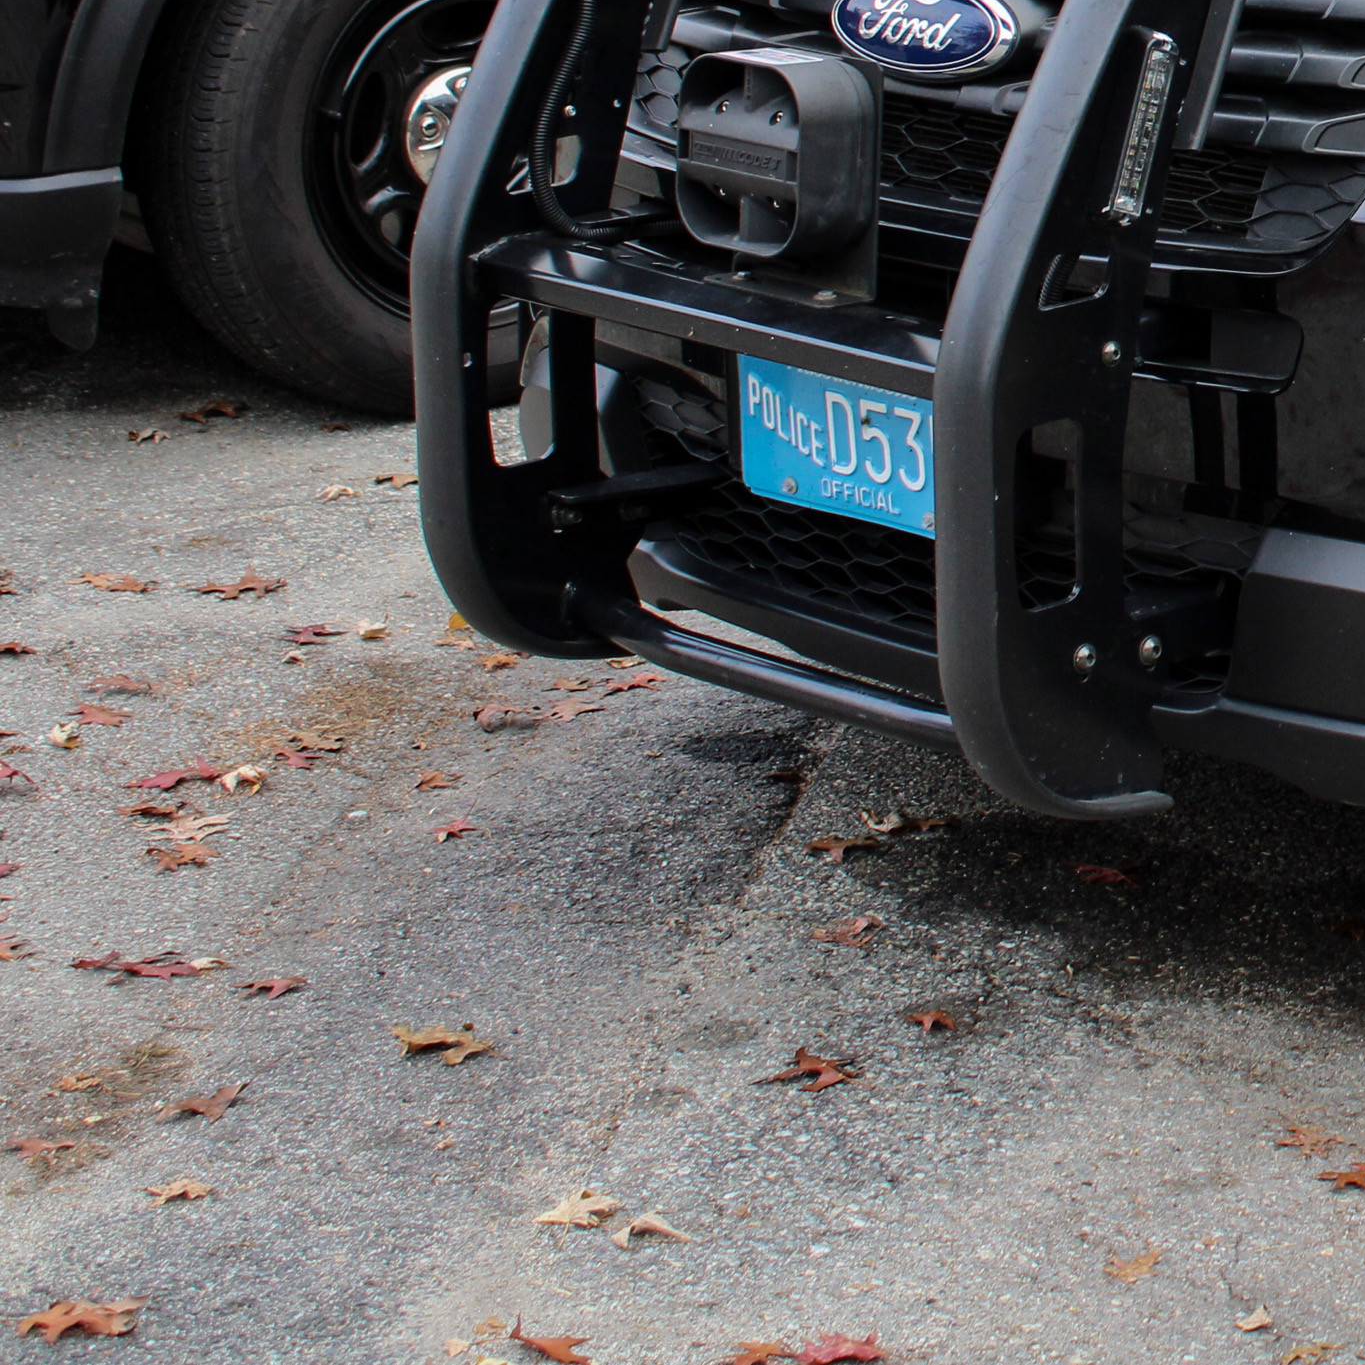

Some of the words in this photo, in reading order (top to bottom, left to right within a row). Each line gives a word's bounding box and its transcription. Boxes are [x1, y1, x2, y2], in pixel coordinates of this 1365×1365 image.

[747, 371, 827, 468] POLICE
[824, 389, 934, 493] D53
[820, 476, 901, 515] OFFICIAL
